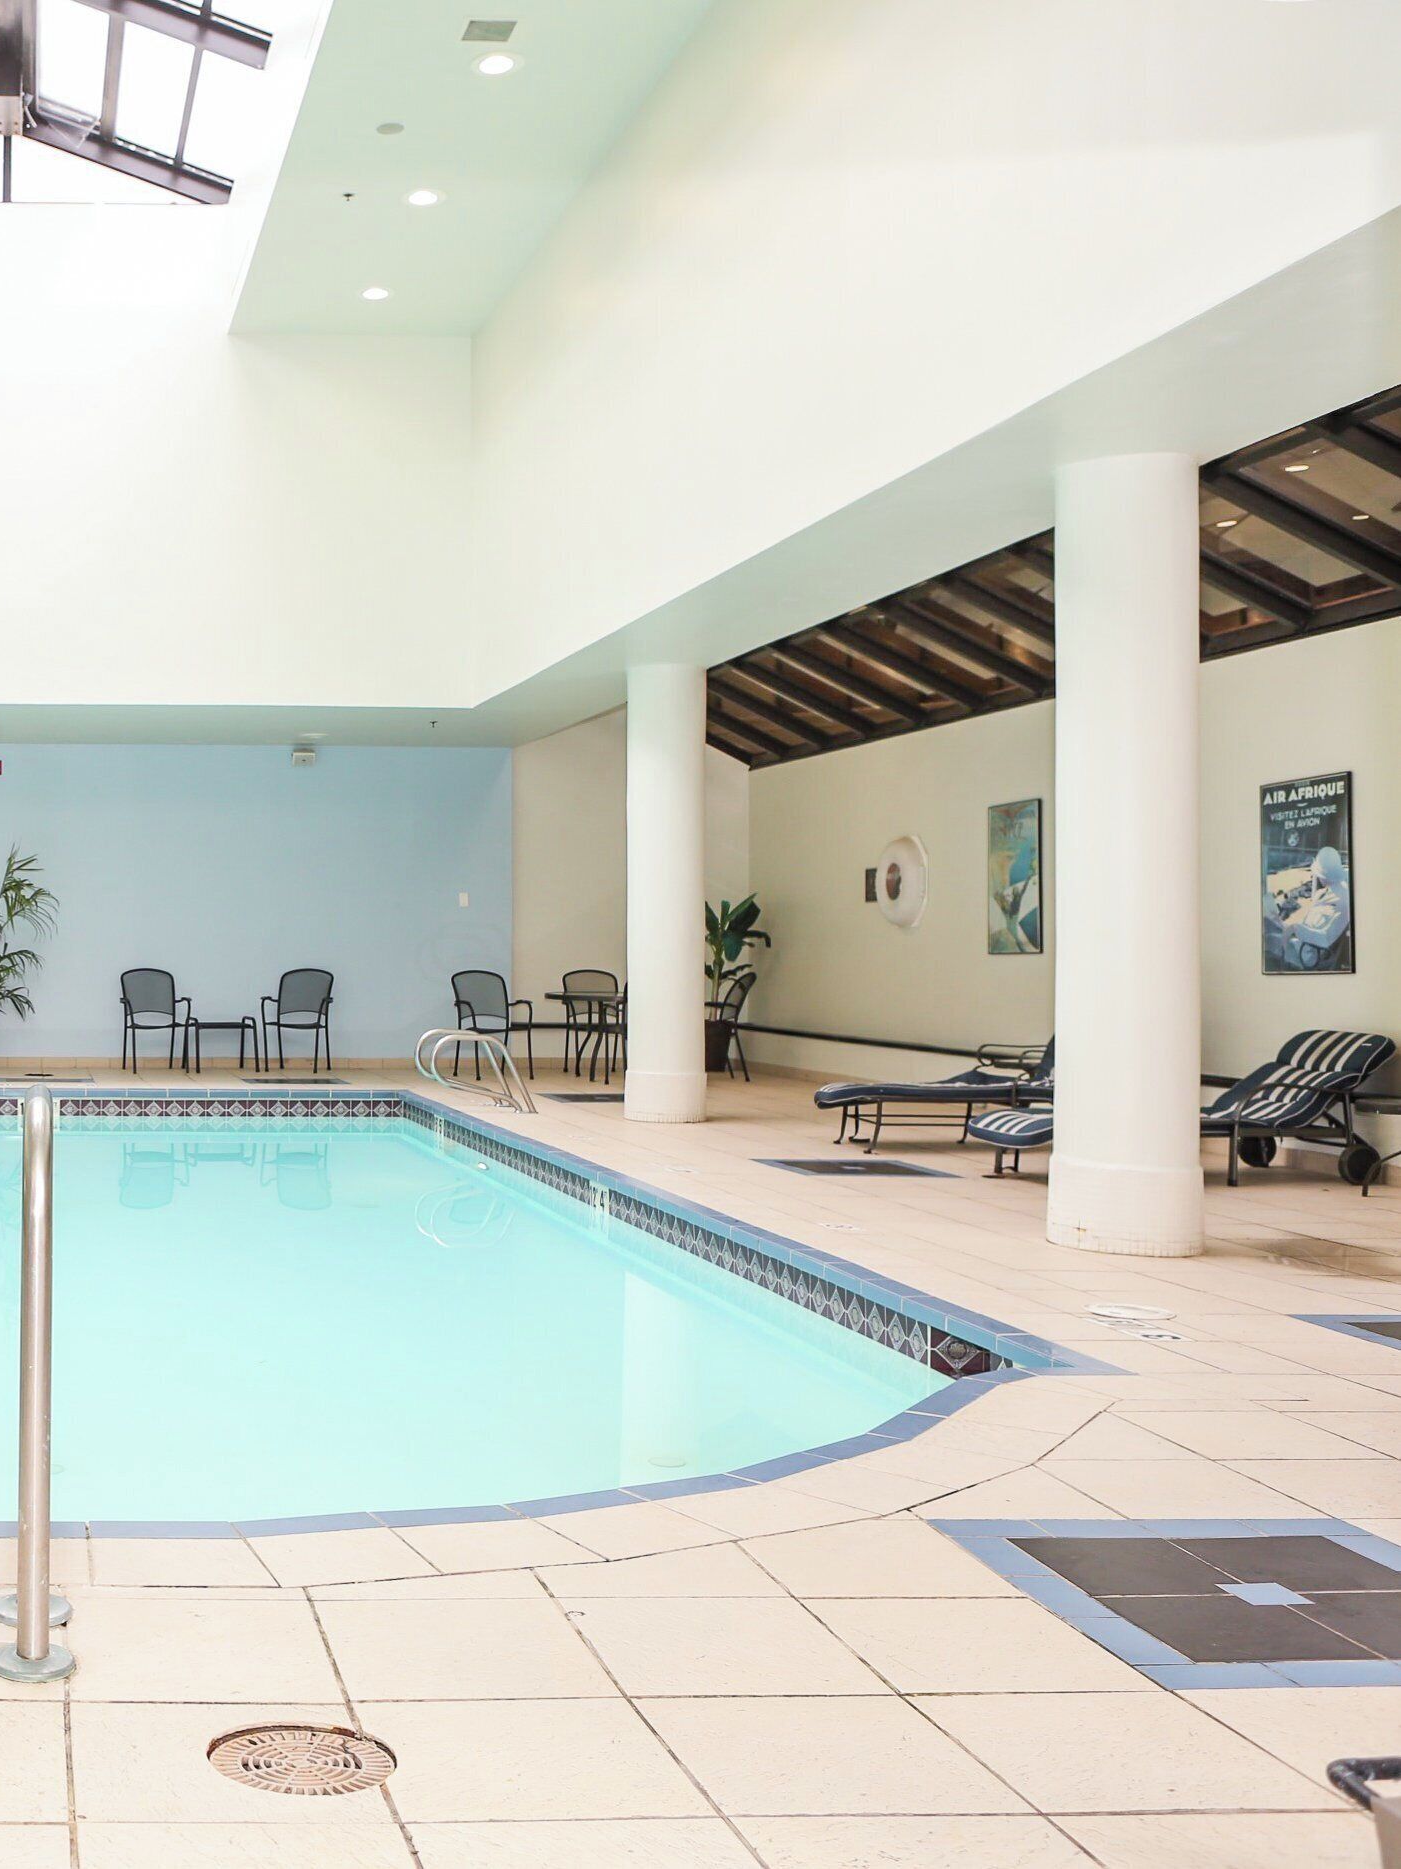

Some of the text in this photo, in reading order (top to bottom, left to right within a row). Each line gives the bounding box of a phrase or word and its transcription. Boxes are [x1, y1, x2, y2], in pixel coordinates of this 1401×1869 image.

[1263, 790, 1286, 805] AIR
[1288, 781, 1345, 800] AFRIQUE
[1270, 810, 1298, 821] VISITEZ
[1284, 817, 1321, 830] EN AVION
